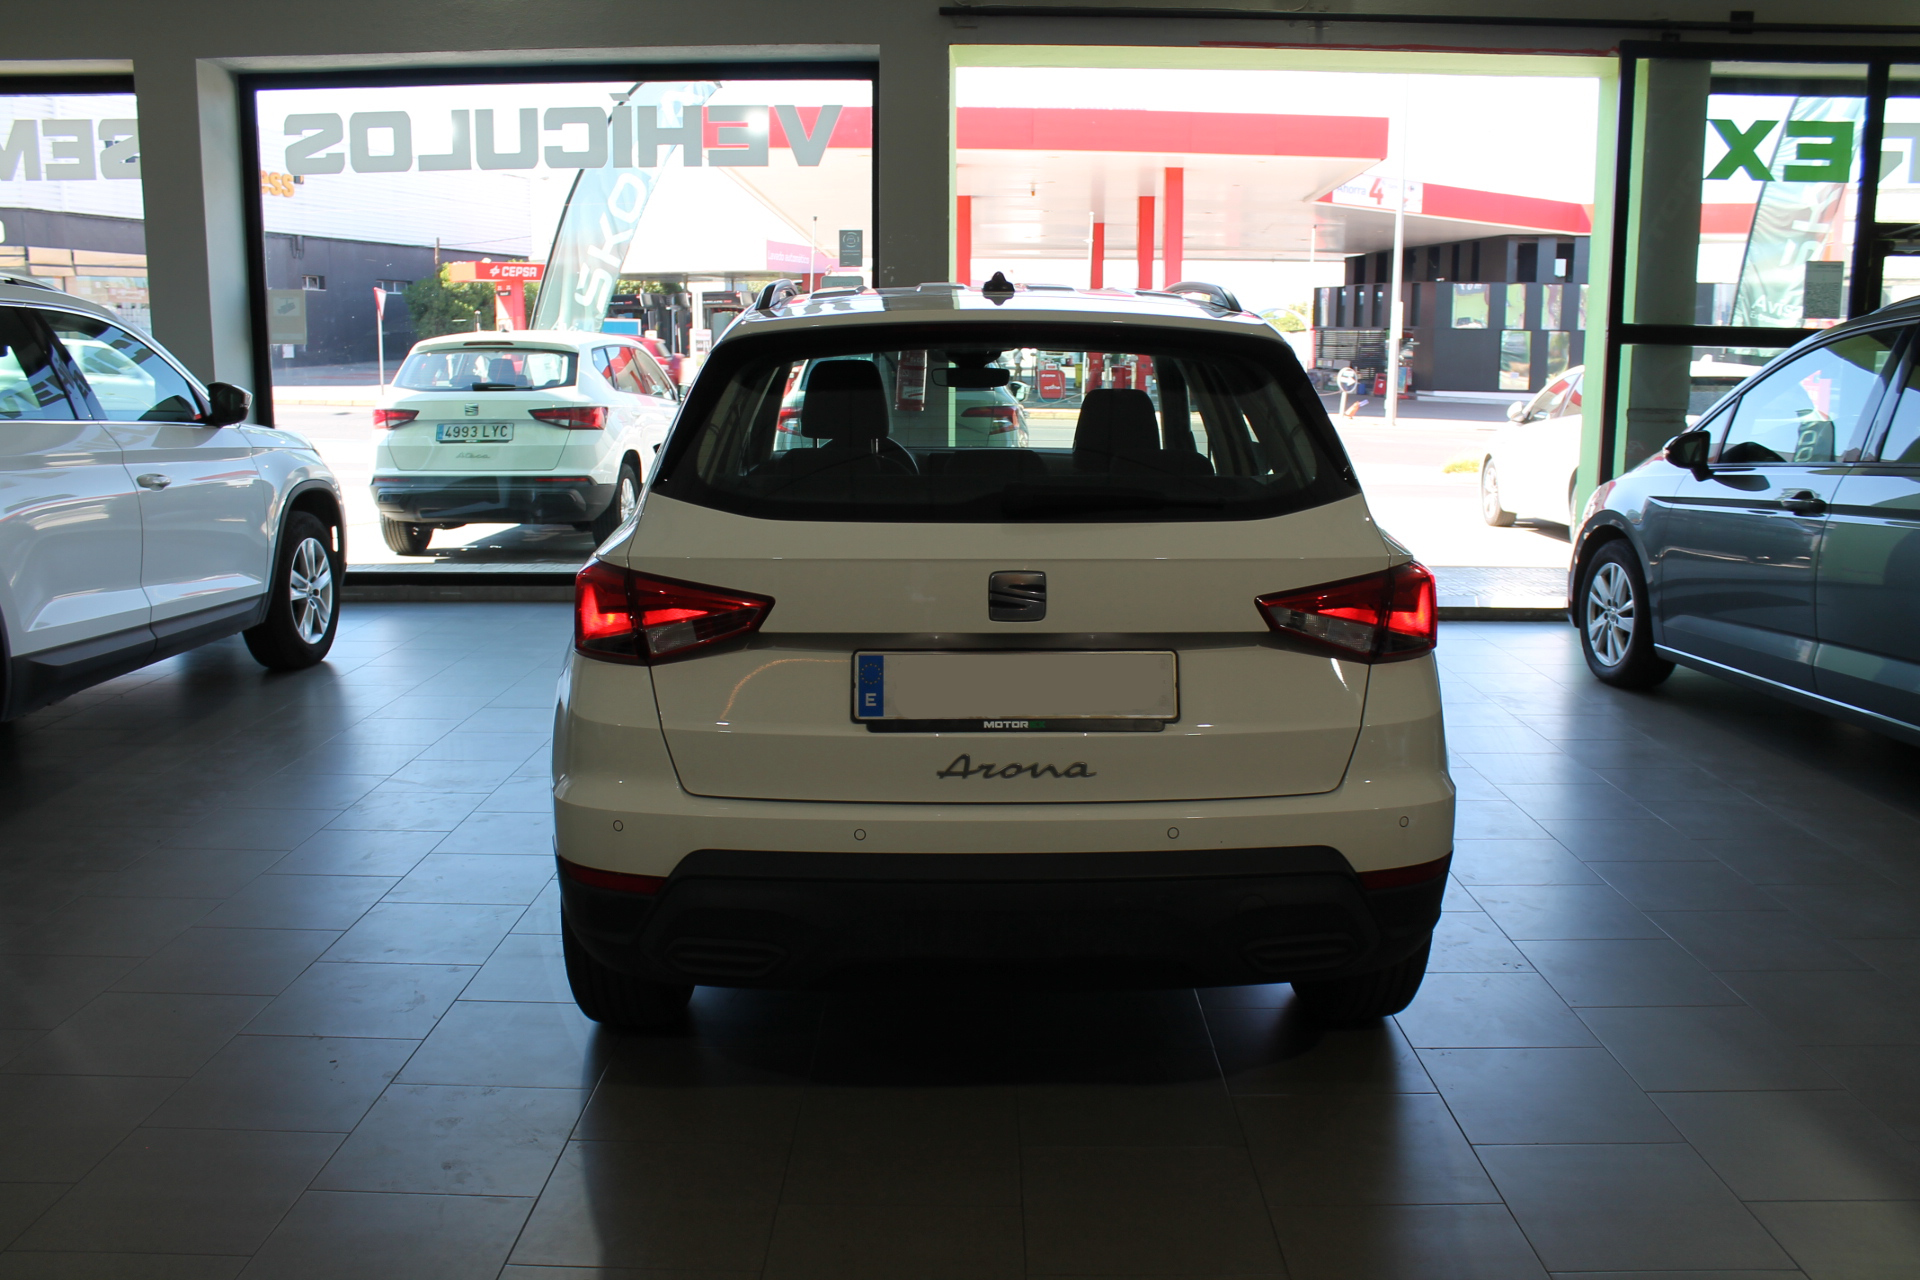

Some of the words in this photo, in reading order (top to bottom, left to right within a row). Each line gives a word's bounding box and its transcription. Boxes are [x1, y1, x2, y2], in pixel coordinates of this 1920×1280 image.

[501, 266, 537, 278] CEPSA
[445, 426, 478, 438] 4993
[482, 425, 508, 438] LYC
[865, 693, 877, 706] E
[983, 720, 1046, 729] MOTOREX
[937, 753, 1097, 779] Arona
